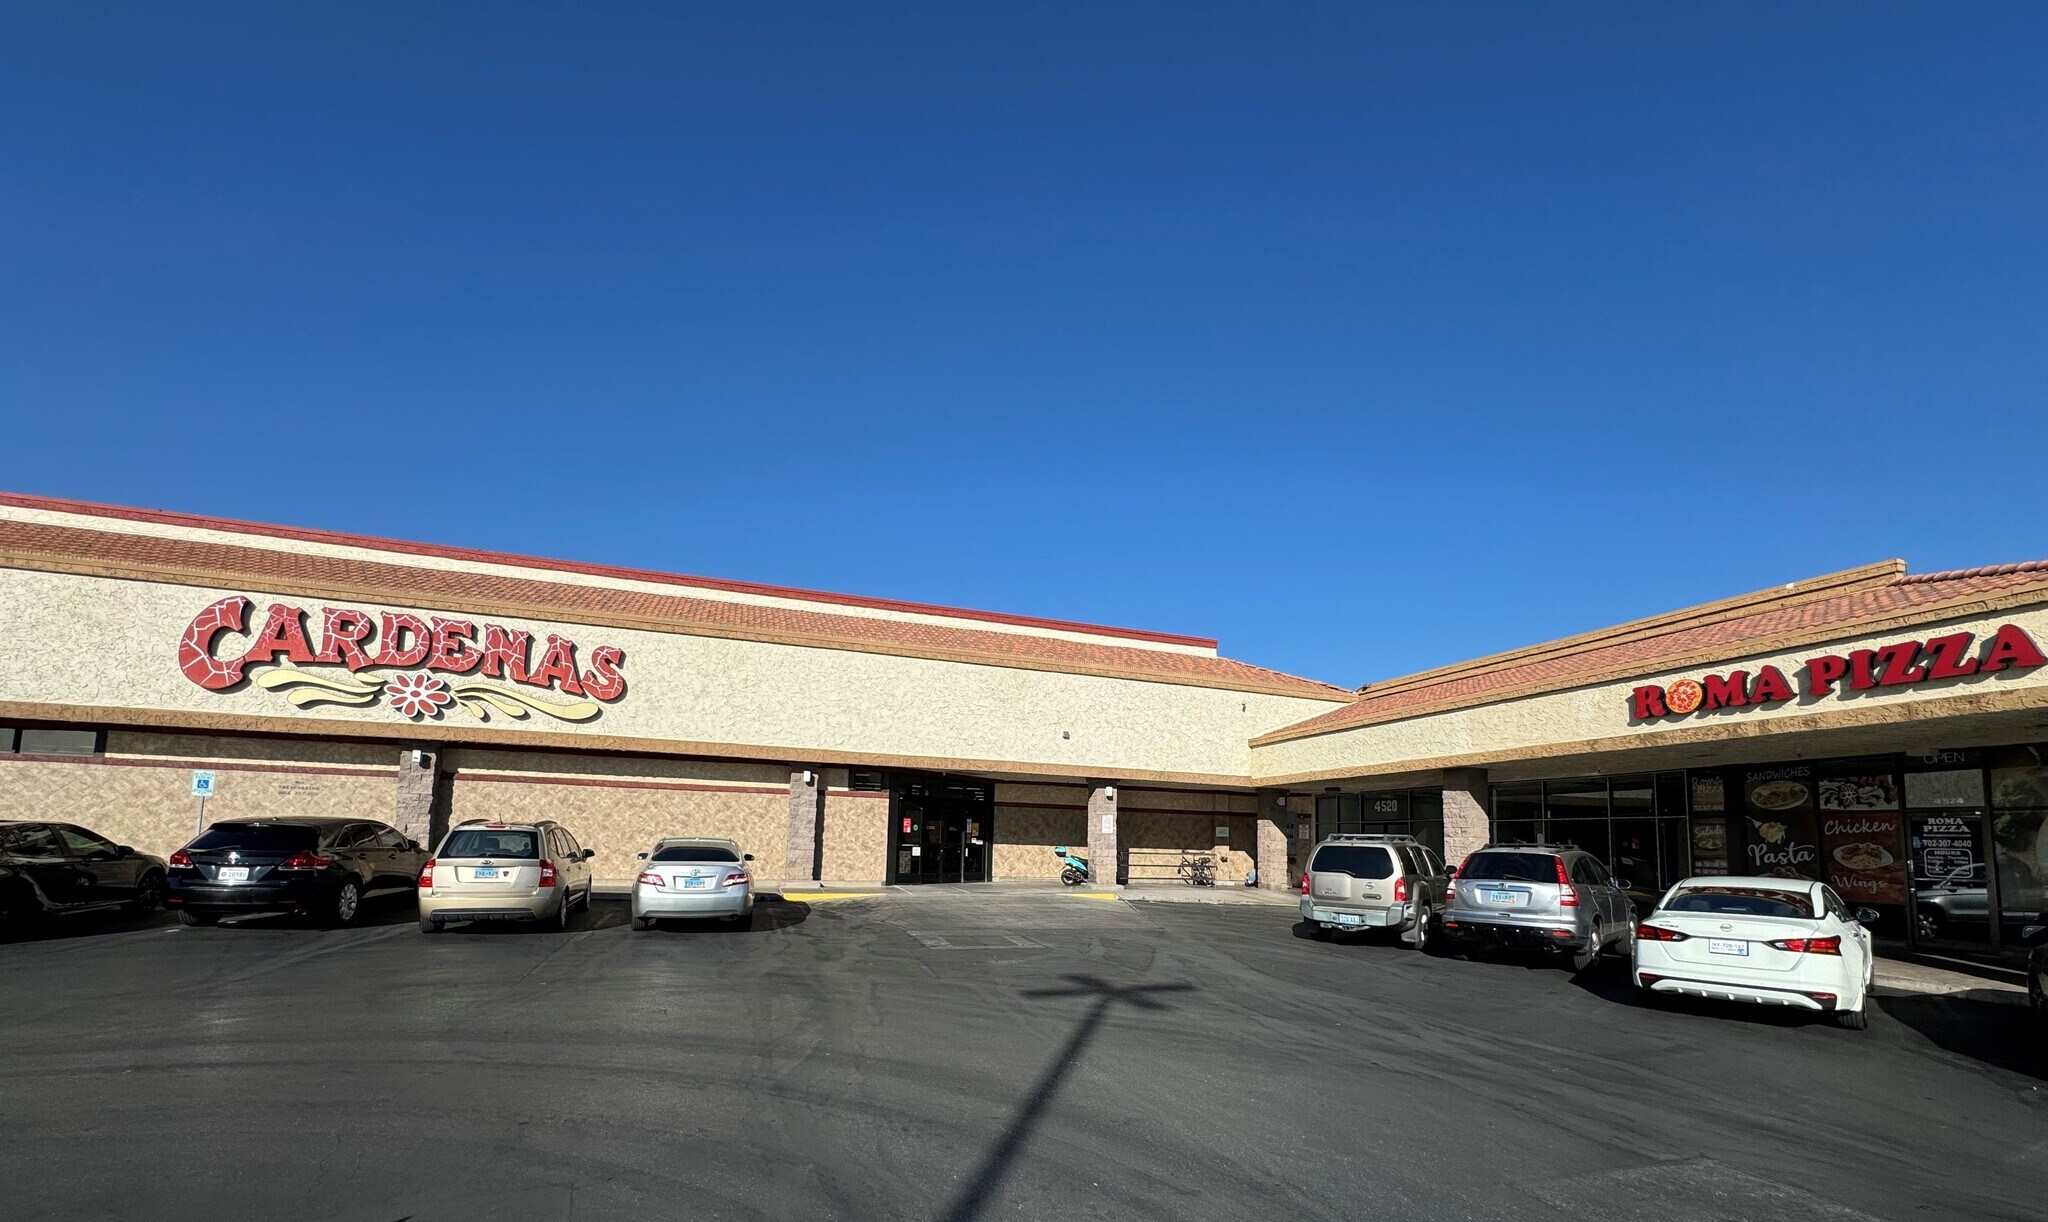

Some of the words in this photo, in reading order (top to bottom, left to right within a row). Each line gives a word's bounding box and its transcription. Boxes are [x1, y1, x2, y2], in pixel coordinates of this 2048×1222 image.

[178, 595, 625, 700] CARDENAS
[1633, 665, 1797, 720] ROMA
[1804, 623, 2048, 697] PIZZA
[1923, 752, 1965, 765] OPEN
[1746, 766, 1811, 782] SANDWICHES
[1691, 776, 1723, 788] Roma
[1374, 799, 1398, 812] 4520
[1824, 818, 1896, 835] Chicken
[1927, 817, 1964, 825] ROMA
[1695, 824, 1724, 838] Salads
[1922, 839, 1972, 847] 702-307-4040
[1747, 841, 1816, 866] Pasta
[1831, 874, 1888, 892] Wings
